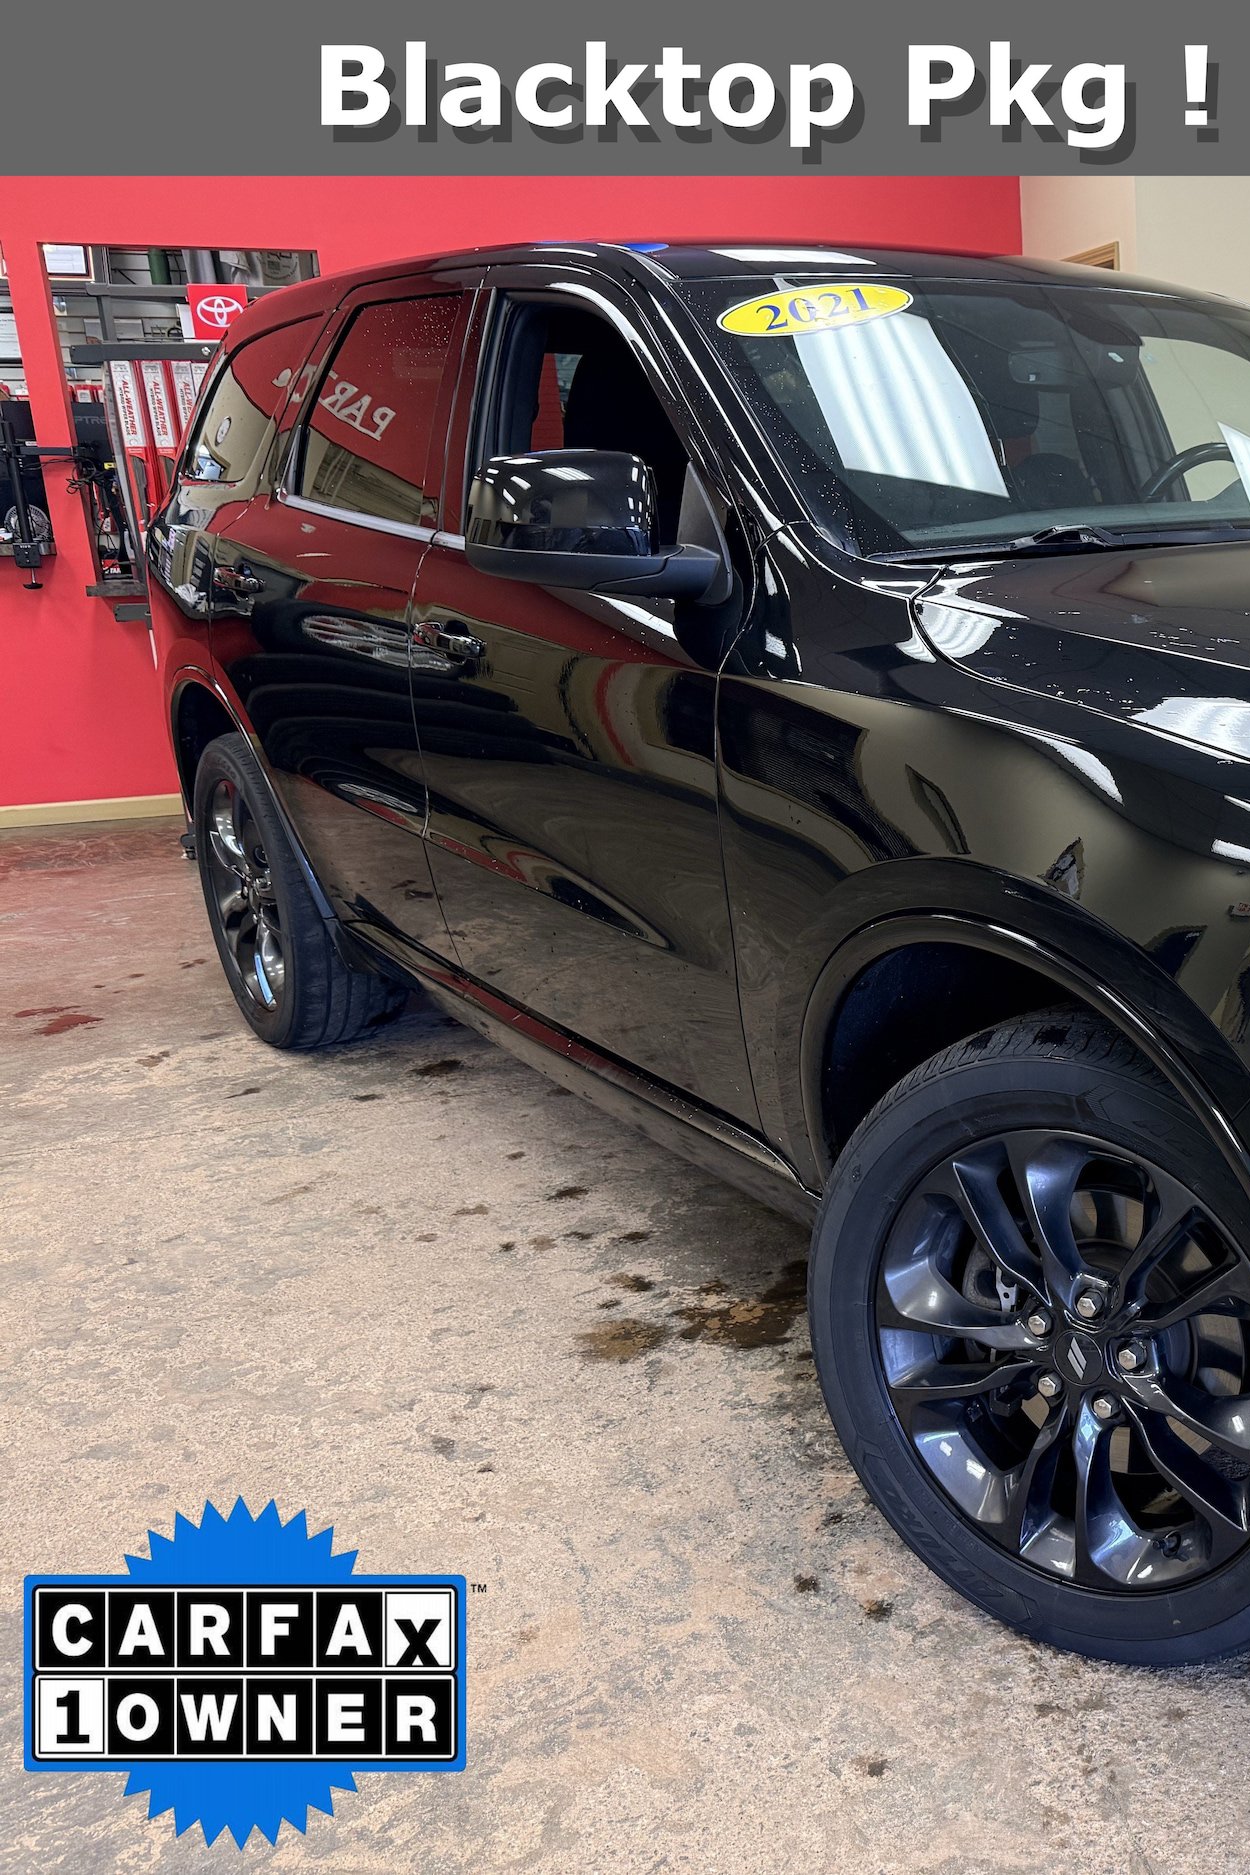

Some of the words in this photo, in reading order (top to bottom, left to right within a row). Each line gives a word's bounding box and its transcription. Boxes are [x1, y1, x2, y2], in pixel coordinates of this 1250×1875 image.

[756, 287, 879, 332] 2021
[121, 380, 137, 435] ALL-WEATHER
[152, 381, 169, 437] ALL-WEATHER
